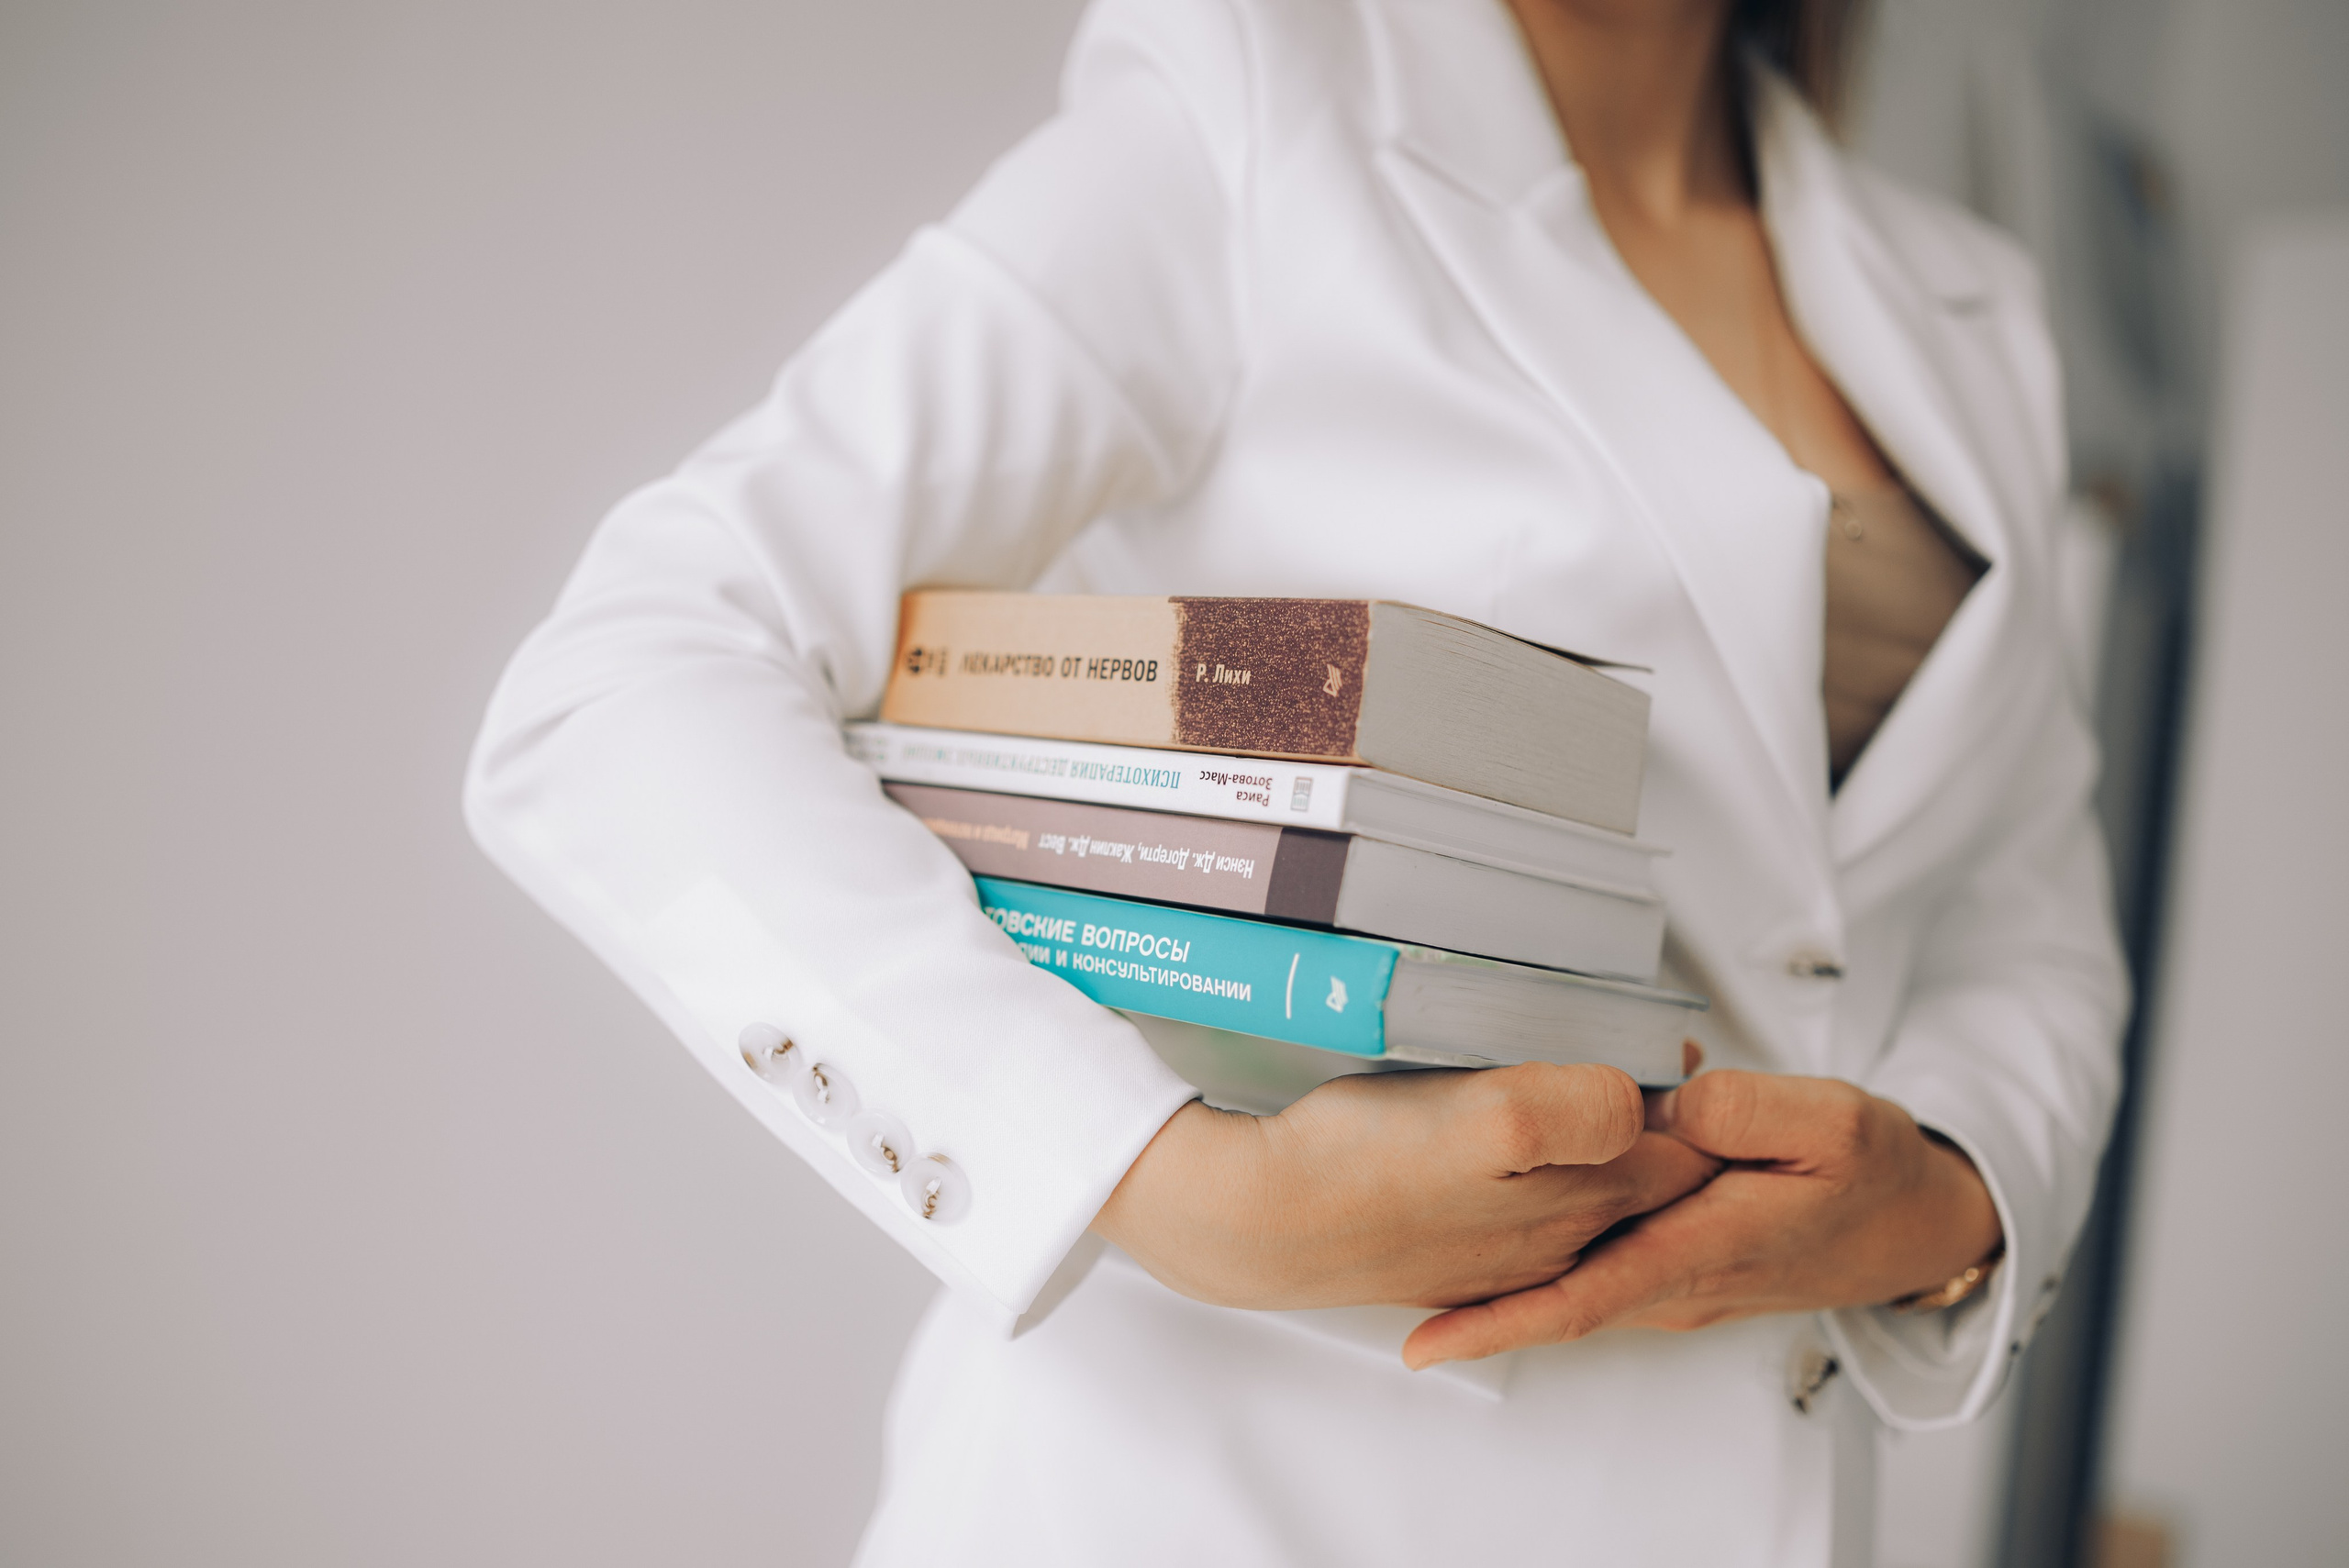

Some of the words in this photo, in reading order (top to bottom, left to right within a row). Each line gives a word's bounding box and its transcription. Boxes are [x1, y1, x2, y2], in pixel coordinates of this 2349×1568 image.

[959, 651, 1054, 677] ЛЕКАРСТВО
[1061, 655, 1082, 678] ОТ
[1086, 656, 1159, 683] НЕРВОВ
[1196, 662, 1209, 683] Р.
[1212, 663, 1252, 685] Лихи
[1070, 759, 1182, 789] ПСИХОТЕРАПИЯ
[1198, 770, 1274, 791] Зотова-Масс
[1236, 791, 1270, 807] Раиса
[1089, 839, 1134, 864] Жаклин
[1138, 840, 1190, 871] Догерти,
[1192, 850, 1216, 874] Дж.
[1216, 854, 1255, 879] Нэнси
[1080, 923, 1191, 963] ВОПРОСЫ
[1055, 949, 1068, 968] И
[1072, 952, 1252, 1002] КОНСУЛЬТИРОВАНИИ
